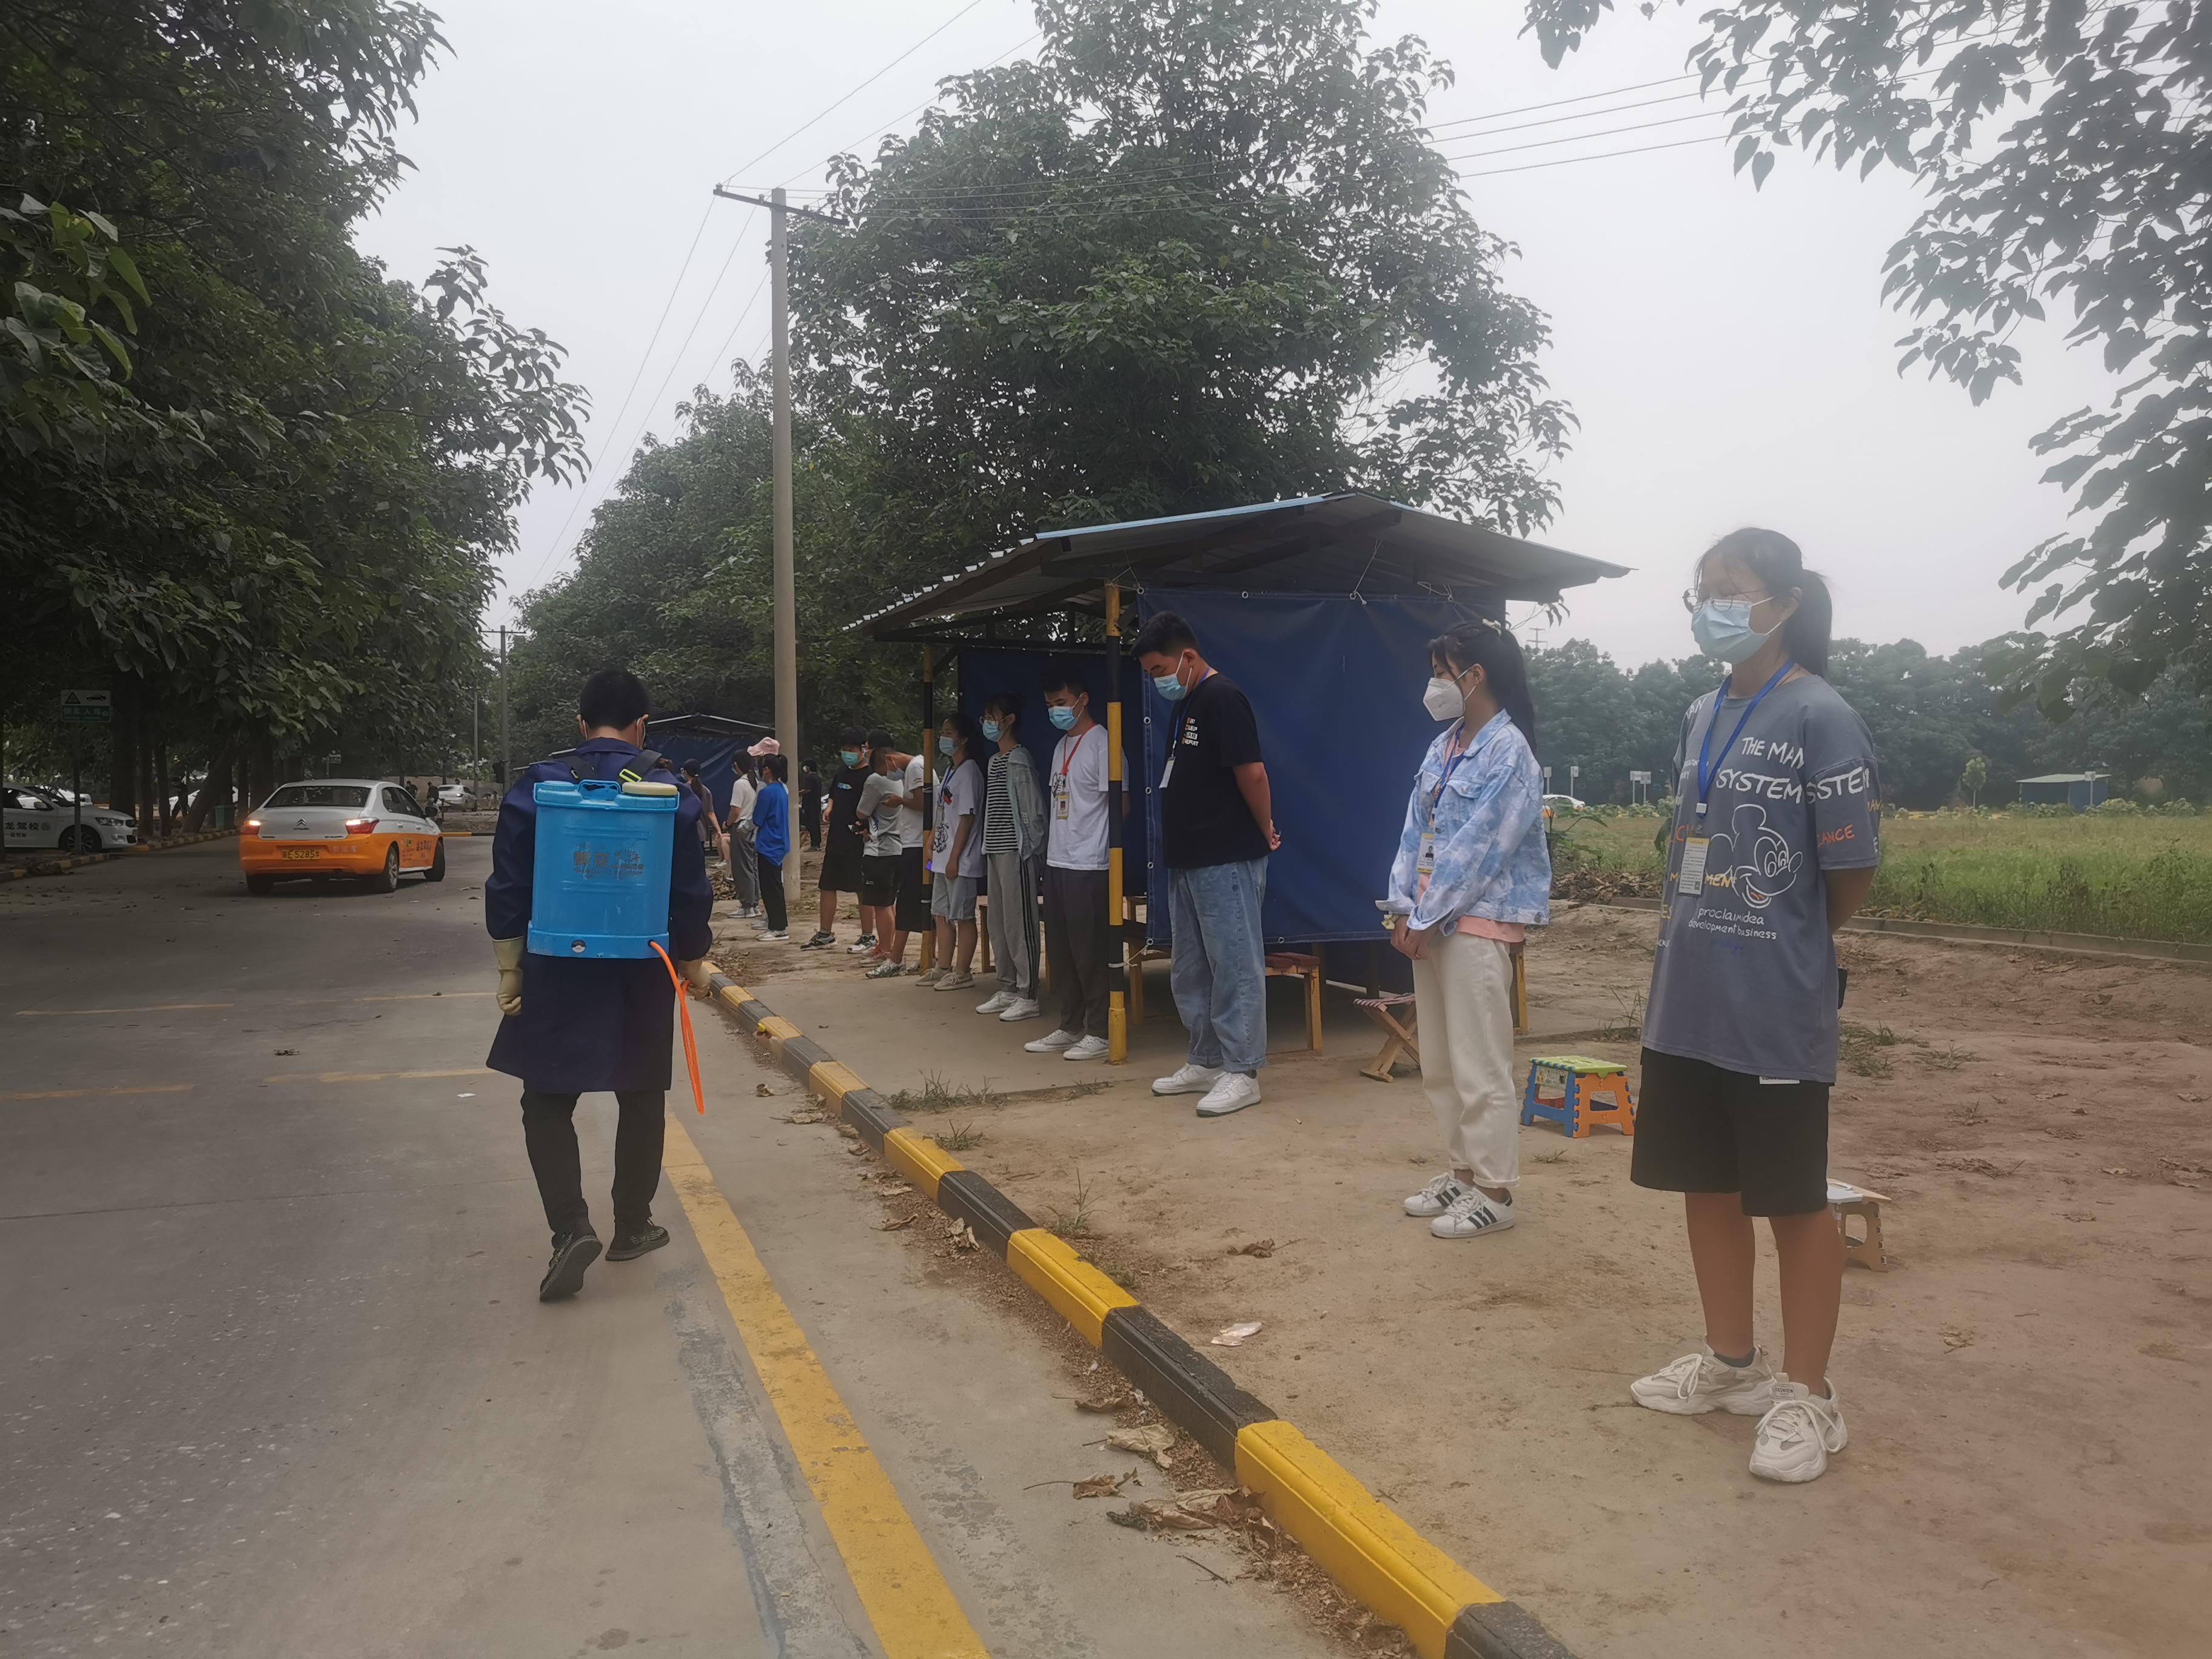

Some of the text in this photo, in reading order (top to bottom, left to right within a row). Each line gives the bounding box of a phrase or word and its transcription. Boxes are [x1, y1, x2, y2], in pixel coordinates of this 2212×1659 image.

[1741, 737, 1805, 769] THE MAN
[1716, 769, 1803, 803] SYSTEM
[1688, 917, 1777, 939] development business
